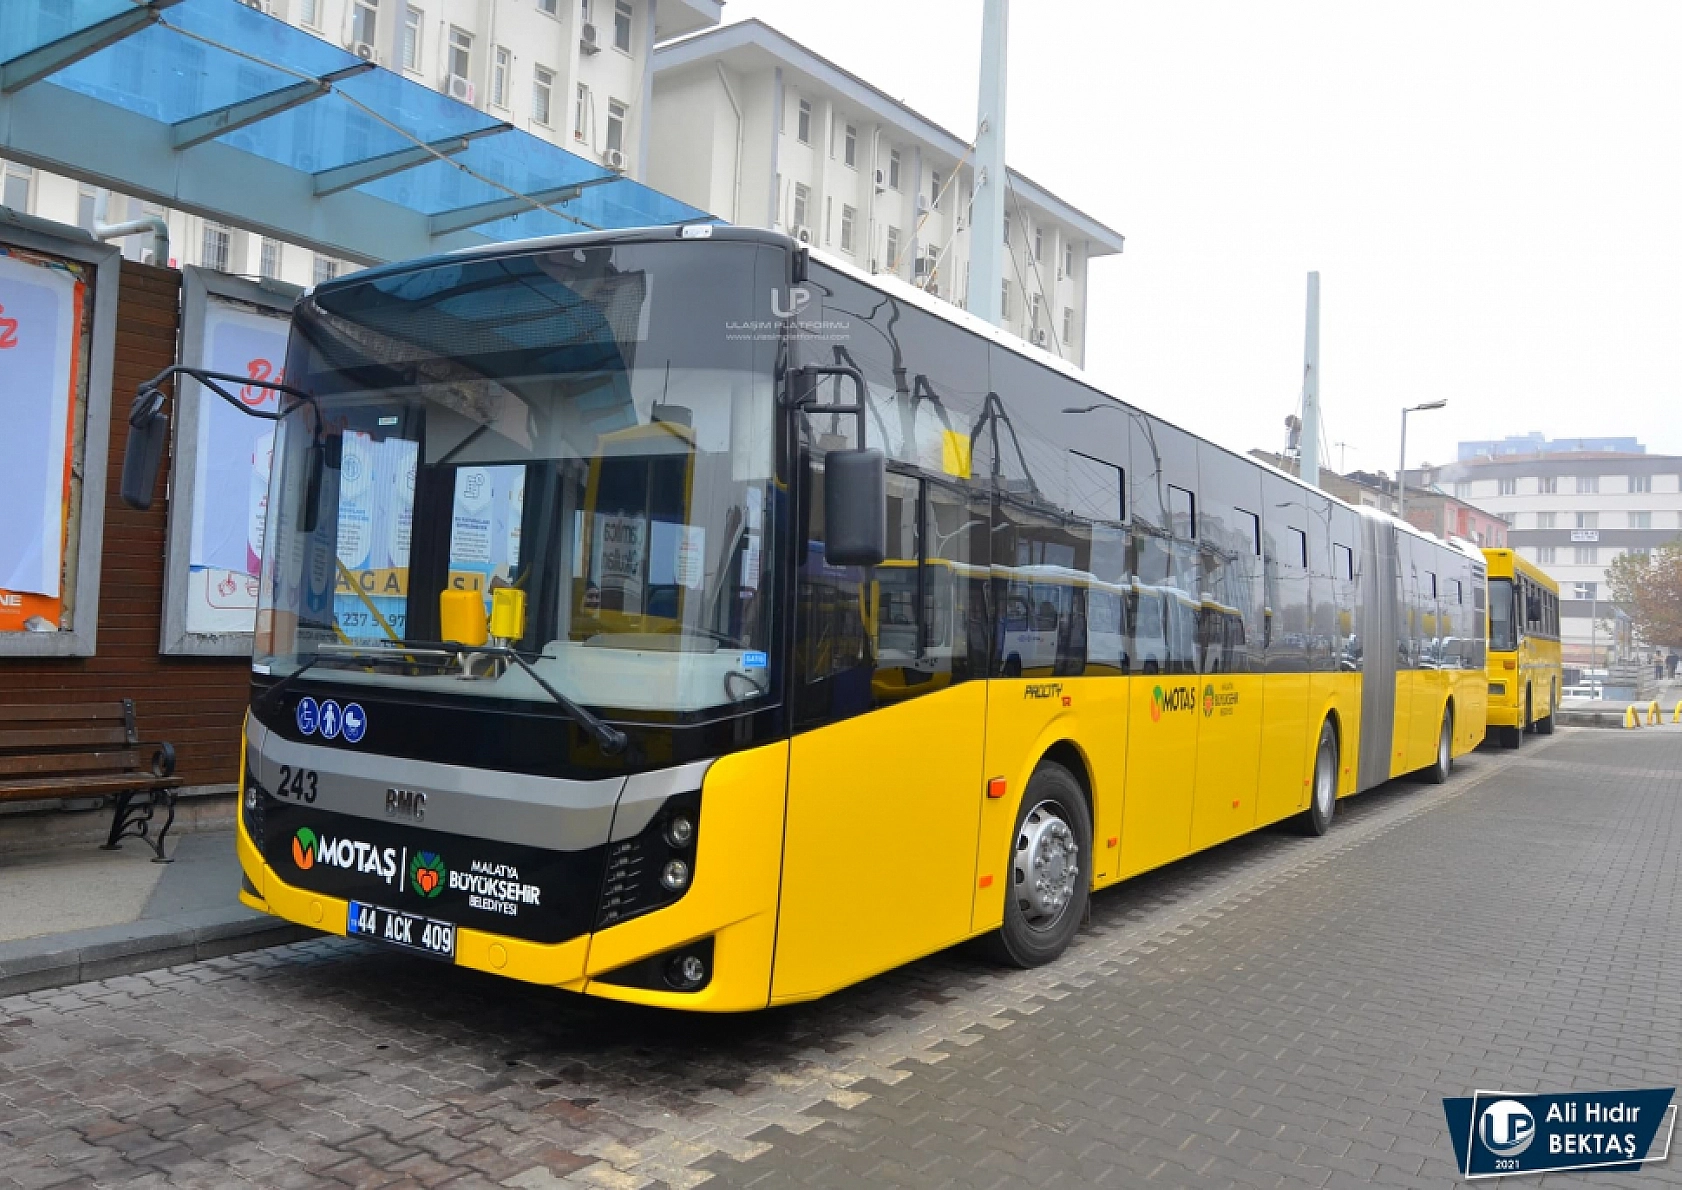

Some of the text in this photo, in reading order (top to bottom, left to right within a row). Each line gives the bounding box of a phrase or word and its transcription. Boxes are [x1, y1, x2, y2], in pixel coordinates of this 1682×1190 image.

[342, 611, 368, 627] 237
[1163, 686, 1196, 715] MOTAŞ
[277, 764, 318, 803] 243
[385, 788, 427, 822] BMC
[317, 834, 397, 885] MOTAŞ
[470, 859, 519, 881] MALATYA
[358, 906, 451, 953] 44 ACK 409
